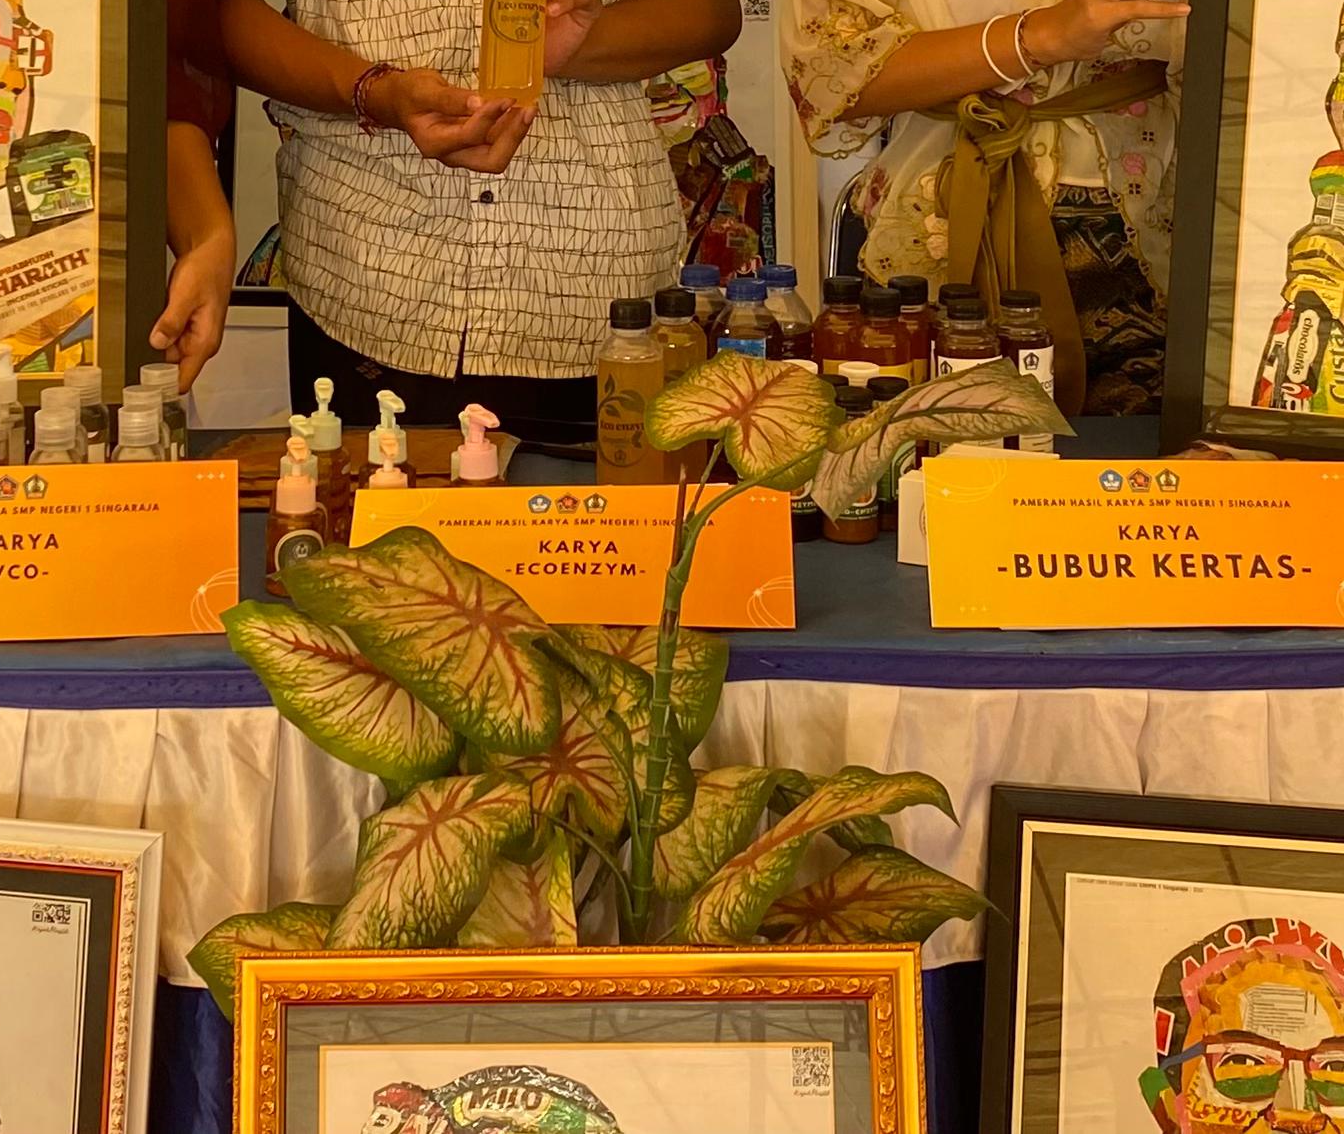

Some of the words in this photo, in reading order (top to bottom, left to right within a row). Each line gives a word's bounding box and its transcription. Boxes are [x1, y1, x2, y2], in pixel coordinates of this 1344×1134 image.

[1013, 499, 1065, 507] PAMERAN
[1070, 499, 1102, 507] HASIL
[1107, 499, 1144, 508] KARYA
[1150, 500, 1171, 508] SMP
[1176, 500, 1215, 508] NEGERI
[1228, 500, 1291, 508] SINGARAJA
[12, 507, 35, 515] SMP
[40, 505, 81, 514] NEGERI
[95, 504, 159, 512] SINGARAJA
[496, 519, 526, 527] HASIL
[601, 519, 639, 527] NEGERI
[1119, 525, 1199, 541] KARYA
[539, 540, 618, 555] KARYA
